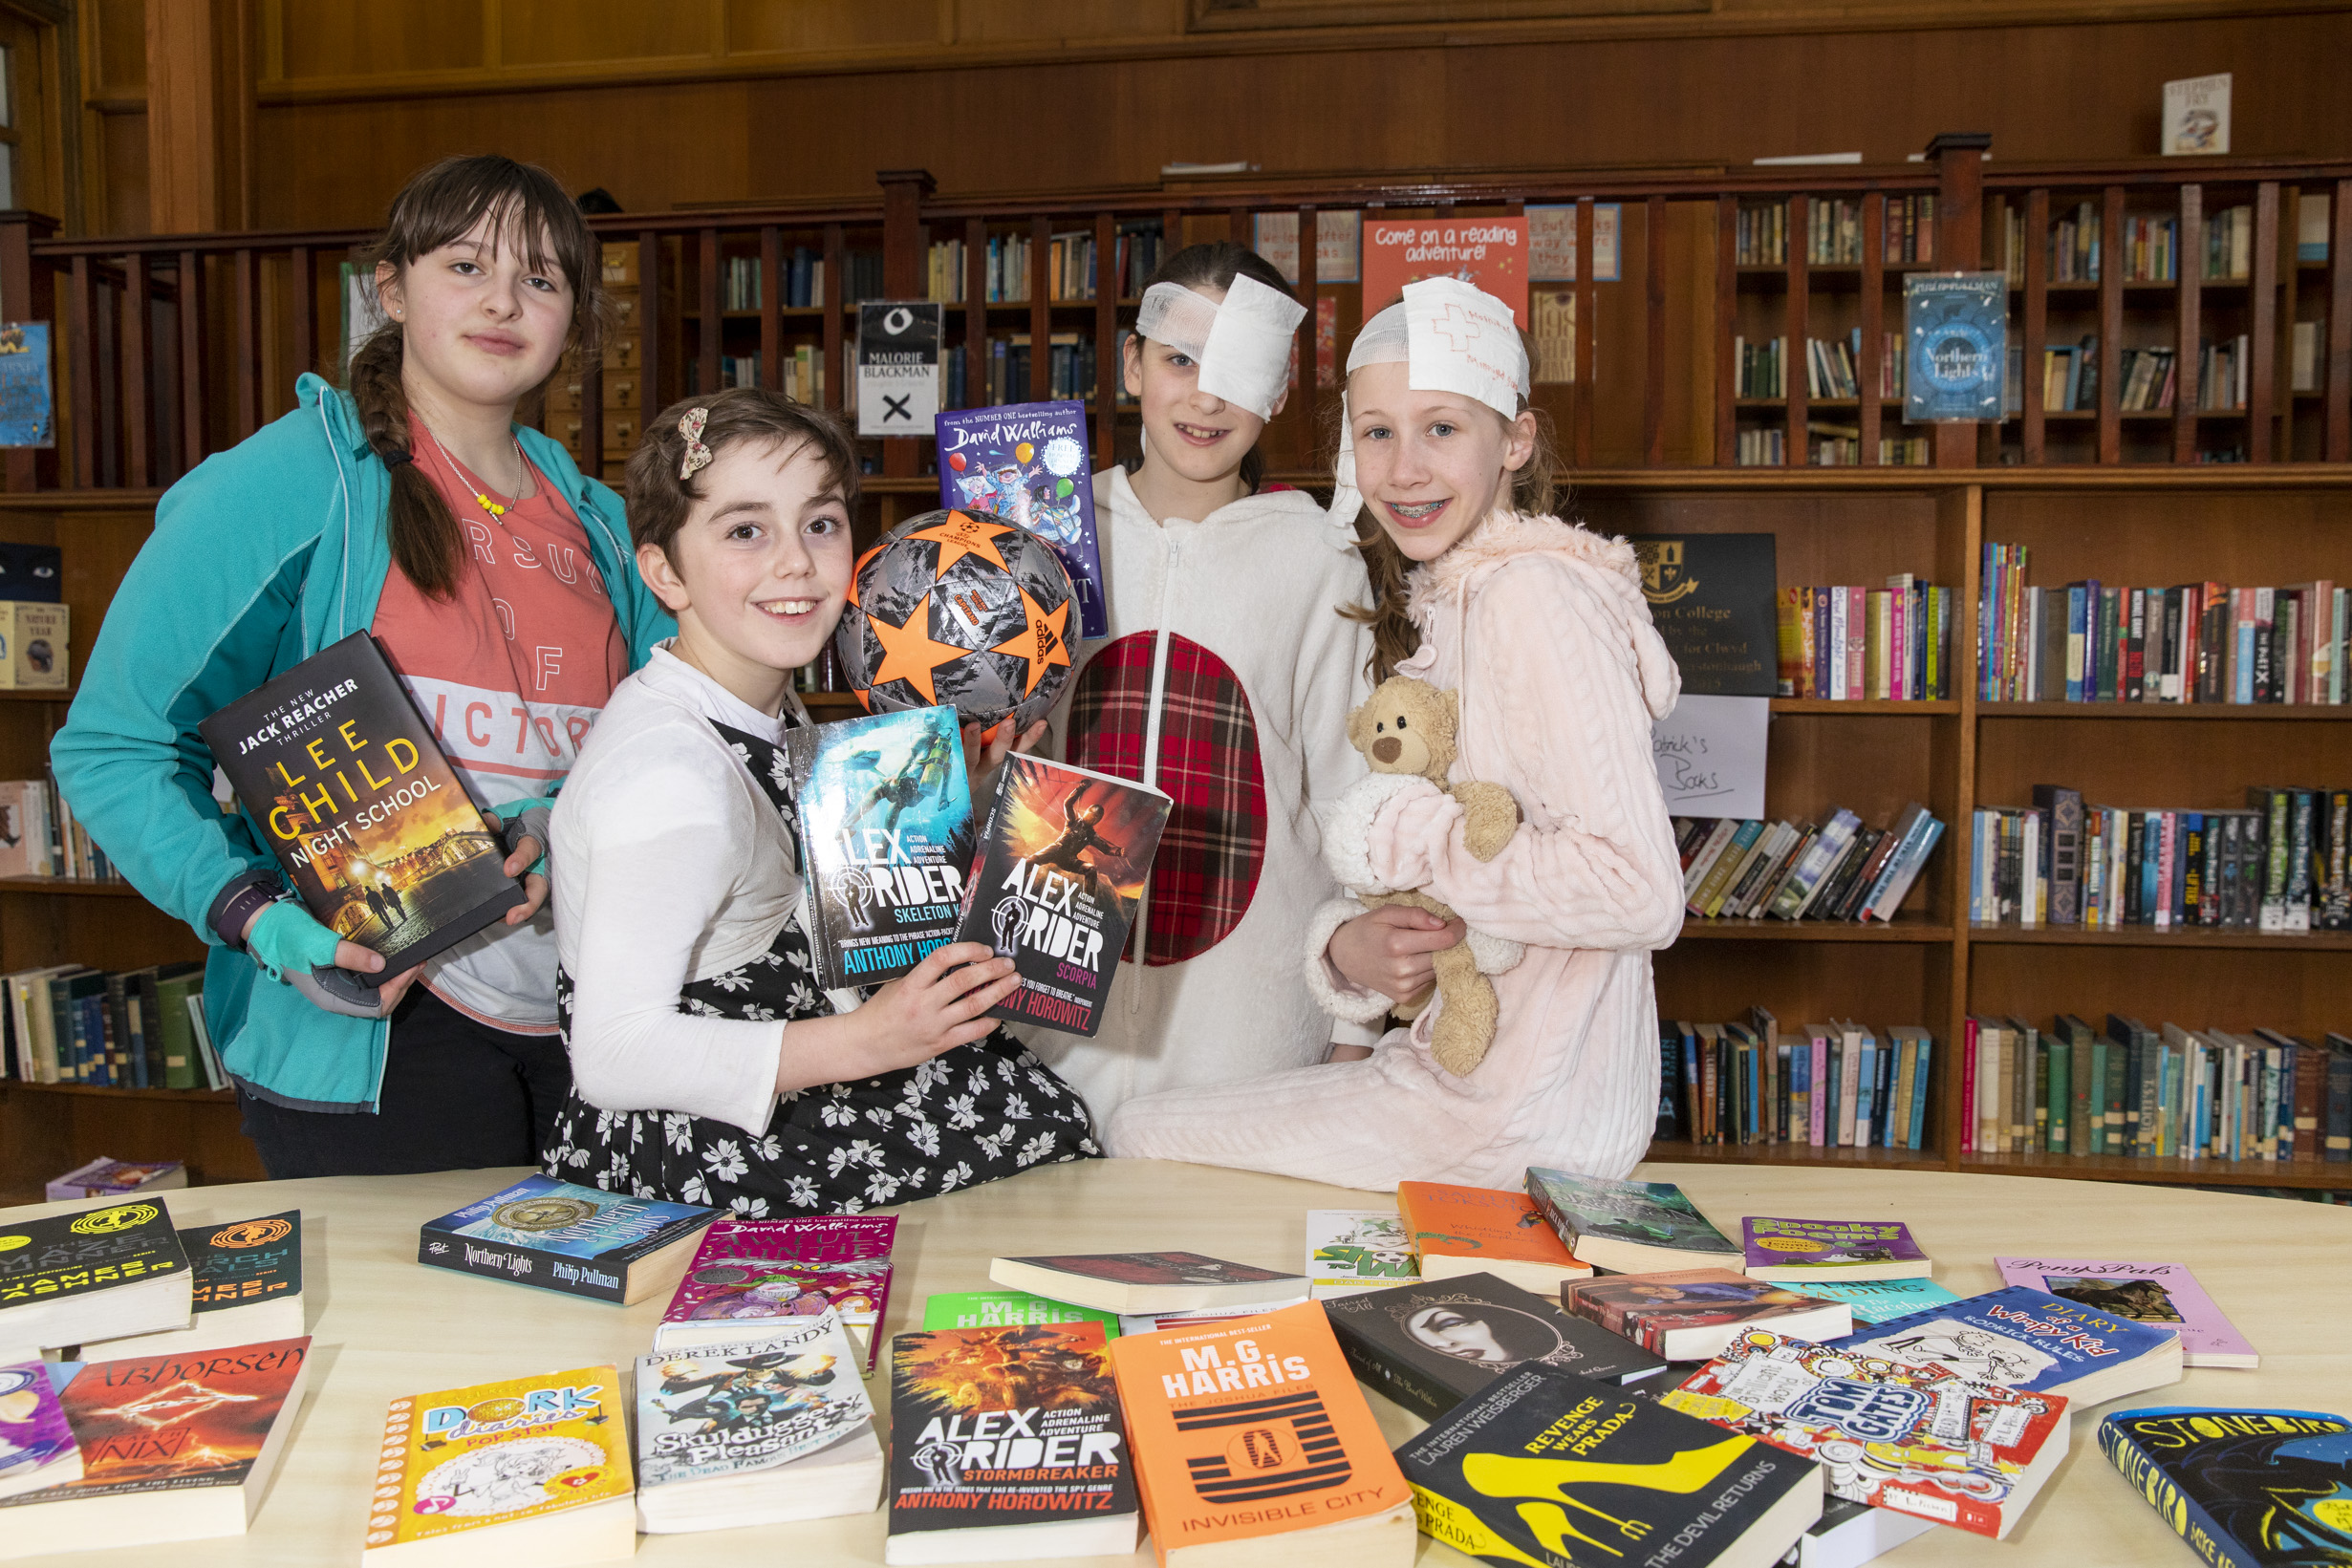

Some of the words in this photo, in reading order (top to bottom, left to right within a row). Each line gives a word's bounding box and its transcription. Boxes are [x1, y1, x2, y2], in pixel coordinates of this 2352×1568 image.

[1375, 227, 1415, 246] Come
[1420, 229, 1439, 246] on
[1444, 230, 1456, 245] a
[1460, 226, 1518, 247] reading
[1406, 245, 1486, 262] adventure!
[868, 352, 924, 364] MALORIE
[1926, 347, 1988, 363] Northern
[864, 366, 931, 377] BLACKMAN
[975, 413, 1002, 422] NUMBER
[1003, 412, 1017, 420] ONE
[1018, 410, 1053, 419] bestselling
[1055, 408, 1076, 417] author
[944, 427, 1001, 451] David
[1003, 421, 1078, 442] Walliams
[939, 532, 982, 548] CHAMPIONS
[954, 594, 980, 626] CAPITANO
[1674, 606, 1732, 621] College
[1035, 619, 1044, 665] adidas
[2255, 671, 2269, 684] X
[238, 722, 282, 755] JACK
[282, 677, 358, 730] REACHER
[264, 704, 285, 722] THE
[291, 688, 315, 707] NEW
[276, 712, 332, 747] THRILLER
[435, 695, 590, 757] ICTOR
[276, 719, 368, 787] LEE
[269, 737, 420, 841] CHILD
[291, 821, 355, 869] NIGHT
[355, 775, 441, 830] SCHOOL
[983, 807, 996, 840] SCORPIA
[841, 828, 912, 866] LEX
[907, 835, 927, 844] ACTION
[910, 845, 946, 853] ADRENALINE
[914, 855, 947, 864] ADVENTURE
[869, 866, 965, 908] RIDER
[1002, 858, 1079, 917] ALEX
[1078, 891, 1095, 904] ACTION
[894, 906, 952, 924] SKELETON
[1072, 912, 1099, 929] ADVENTURE
[1075, 901, 1104, 920] ADRENALINE
[1022, 906, 1103, 972] RIDER
[844, 942, 915, 976] ANTHONY
[1035, 980, 1050, 996] FORGET
[1056, 962, 1097, 989] SCORPIA
[1027, 991, 1091, 1031] HOROWITZ
[460, 1200, 490, 1220] Philip
[490, 1187, 531, 1209] Pullman
[548, 1203, 651, 1243] Northern
[584, 1213, 672, 1243] Lights
[713, 1224, 787, 1235] David
[794, 1222, 889, 1233] Walliams
[1751, 1218, 1902, 1234] Spooky
[1753, 1225, 1900, 1240] Poems
[711, 1244, 874, 1259] AUNTIE
[718, 1232, 874, 1246] AWFUL
[464, 1243, 503, 1269] Northern
[503, 1252, 532, 1277] Lights
[552, 1261, 579, 1285] Philip
[580, 1267, 619, 1289] Pullman
[2007, 1259, 2089, 1274] Pony
[2087, 1263, 2170, 1276] Pals
[2, 1260, 143, 1292] JAMES
[3, 1261, 175, 1300] ASHNER
[1325, 1297, 1370, 1310] Fairest
[2041, 1302, 2130, 1333] DIARY
[1175, 1331, 1227, 1344] INTERNATIONAL
[1229, 1324, 1272, 1337] BEST-SELLER
[1987, 1305, 2069, 1338] Wimpy
[2061, 1333, 2119, 1357] Kid
[2047, 1316, 2072, 1324] of
[645, 1348, 737, 1366] DEREK
[745, 1318, 834, 1355] LANDY
[1964, 1315, 2033, 1342] RODRICK
[2033, 1339, 2084, 1363] RULES
[1169, 1401, 1196, 1409] THE
[1205, 1392, 1266, 1405] JOSHUA
[1274, 1384, 1314, 1395] FILES
[1737, 1365, 1781, 1404] Brilliant
[426, 1386, 600, 1432] DORK
[1043, 1408, 1082, 1419] ACTION
[1409, 1446, 1425, 1461] THE
[1425, 1405, 1489, 1449] INTERNATIONAL
[1489, 1371, 1533, 1407] BESTSELLER
[1801, 1385, 1862, 1424] TOM
[1851, 1388, 1917, 1435] GATES
[449, 1409, 587, 1439] diaries
[655, 1394, 862, 1453] Skulduggery
[916, 1407, 1041, 1445] ALEX
[1039, 1424, 1104, 1436] ADVENTURE
[1041, 1414, 1111, 1428] ADRENALINE
[1418, 1424, 1471, 1466] LAUREN
[1471, 1374, 1547, 1430] WEISBERGER
[1524, 1395, 1605, 1456] REVENGE
[1572, 1403, 1638, 1458] PRADA
[2134, 1415, 2345, 1449] STONEBIRD
[98, 1438, 180, 1463] NIX
[467, 1433, 507, 1448] POP
[509, 1423, 558, 1438] Star
[688, 1418, 833, 1466] Pleasant
[1552, 1418, 1599, 1453] WEARS
[960, 1432, 1121, 1470] RIDER
[963, 1465, 1118, 1481] STORMBREAKER
[2100, 1422, 2188, 1536] STONEBIRD
[895, 1493, 983, 1510] ANTHONY
[987, 1492, 1113, 1511] HOROWITZ
[1087, 1484, 1113, 1493] GENRE
[1326, 1487, 1384, 1510] CITY
[417, 1527, 447, 1537] Tales
[452, 1520, 482, 1532] from
[1182, 1502, 1318, 1532] INVISIBLE
[1644, 1539, 1682, 1568] THE
[1678, 1502, 1725, 1549] DEVIL
[1717, 1460, 1777, 1508] RETURNS
[1426, 1516, 1486, 1550] PRADA
[2191, 1522, 2216, 1564] MIKE
